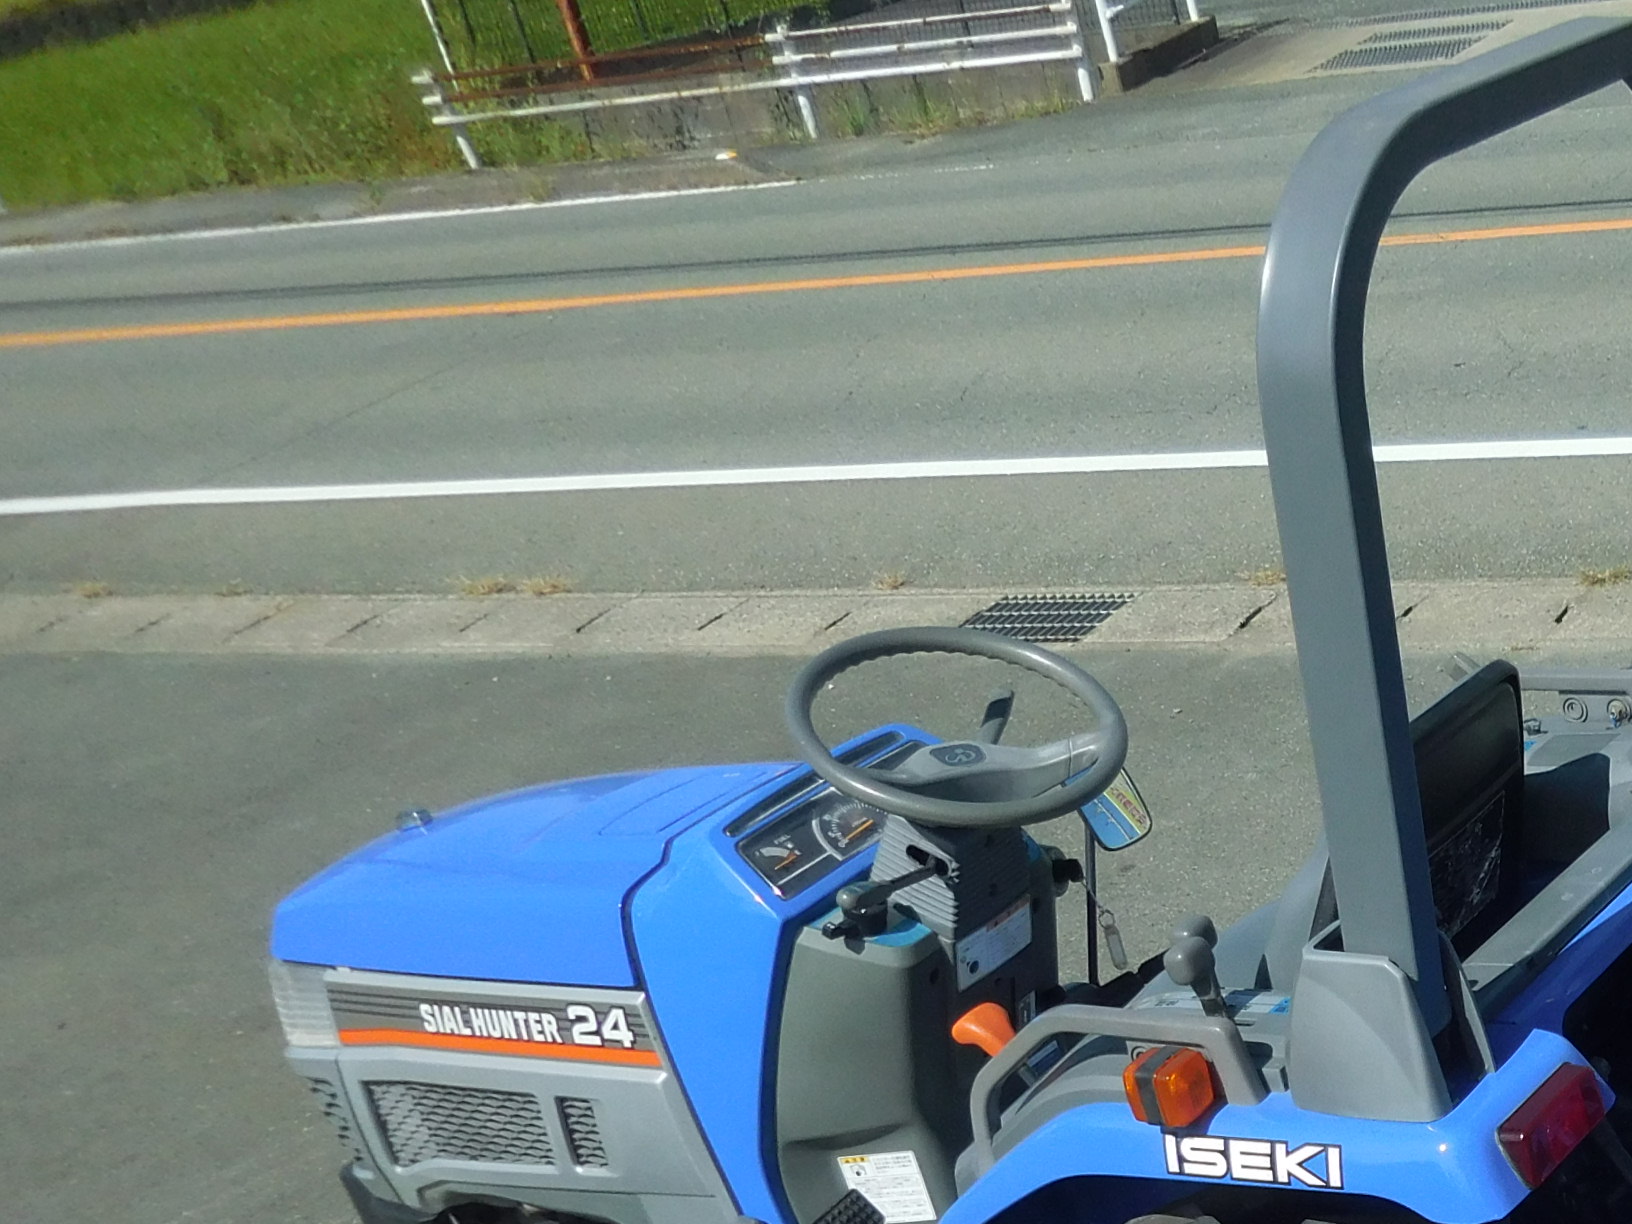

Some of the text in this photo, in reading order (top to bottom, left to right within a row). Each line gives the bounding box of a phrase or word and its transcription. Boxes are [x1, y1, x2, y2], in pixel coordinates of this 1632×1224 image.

[418, 1003, 635, 1048] SIAL HUNTER 24
[1164, 1134, 1343, 1188] ISEKI
